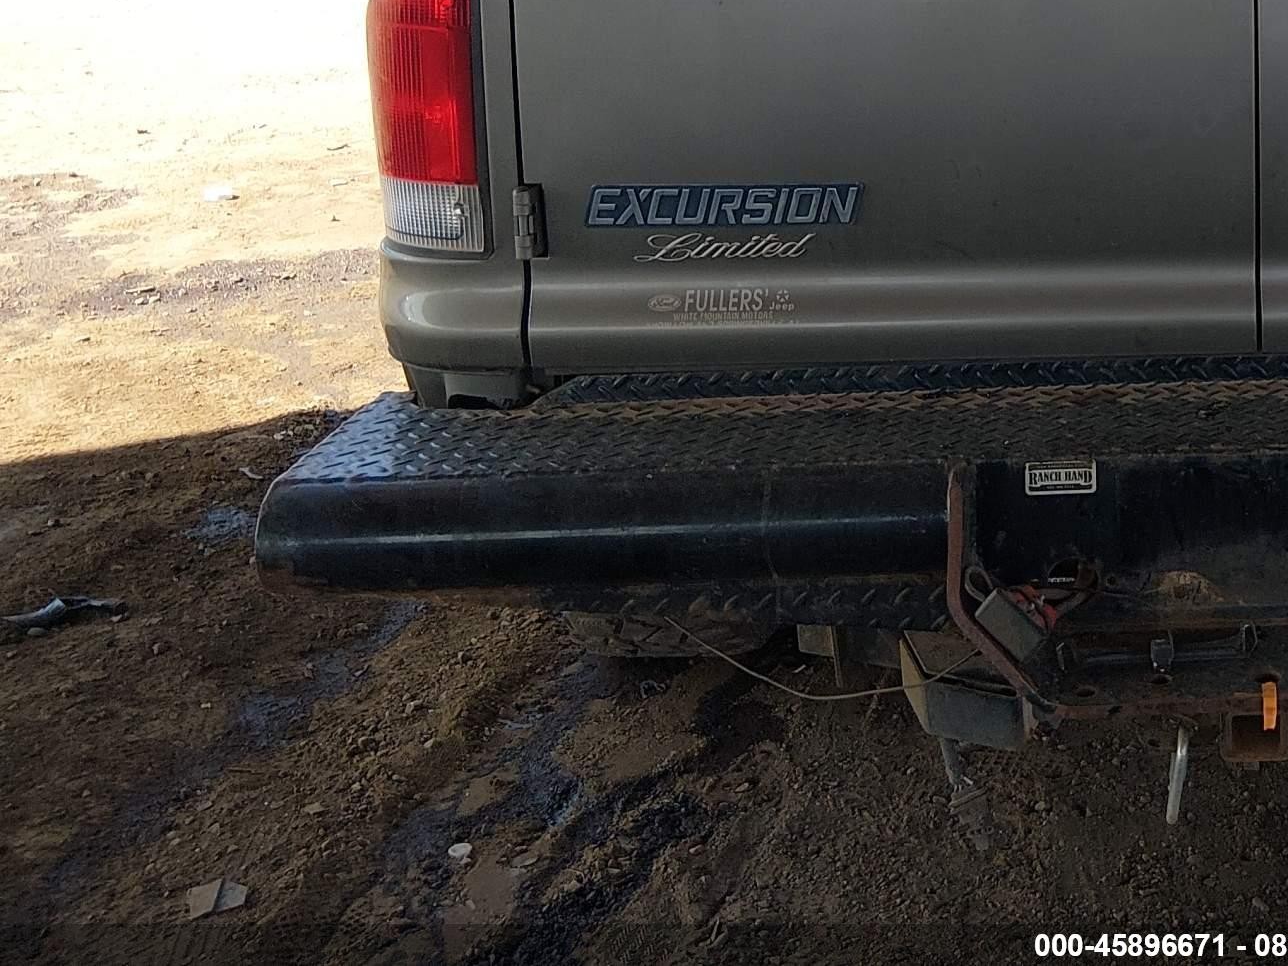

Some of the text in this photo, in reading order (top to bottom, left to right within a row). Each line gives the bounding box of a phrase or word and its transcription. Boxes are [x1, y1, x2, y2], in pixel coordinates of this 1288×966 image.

[586, 184, 862, 227] EXCURSION
[633, 233, 817, 262] Limited
[768, 300, 796, 312] Jeep
[1028, 469, 1093, 486] RANCH HAND
